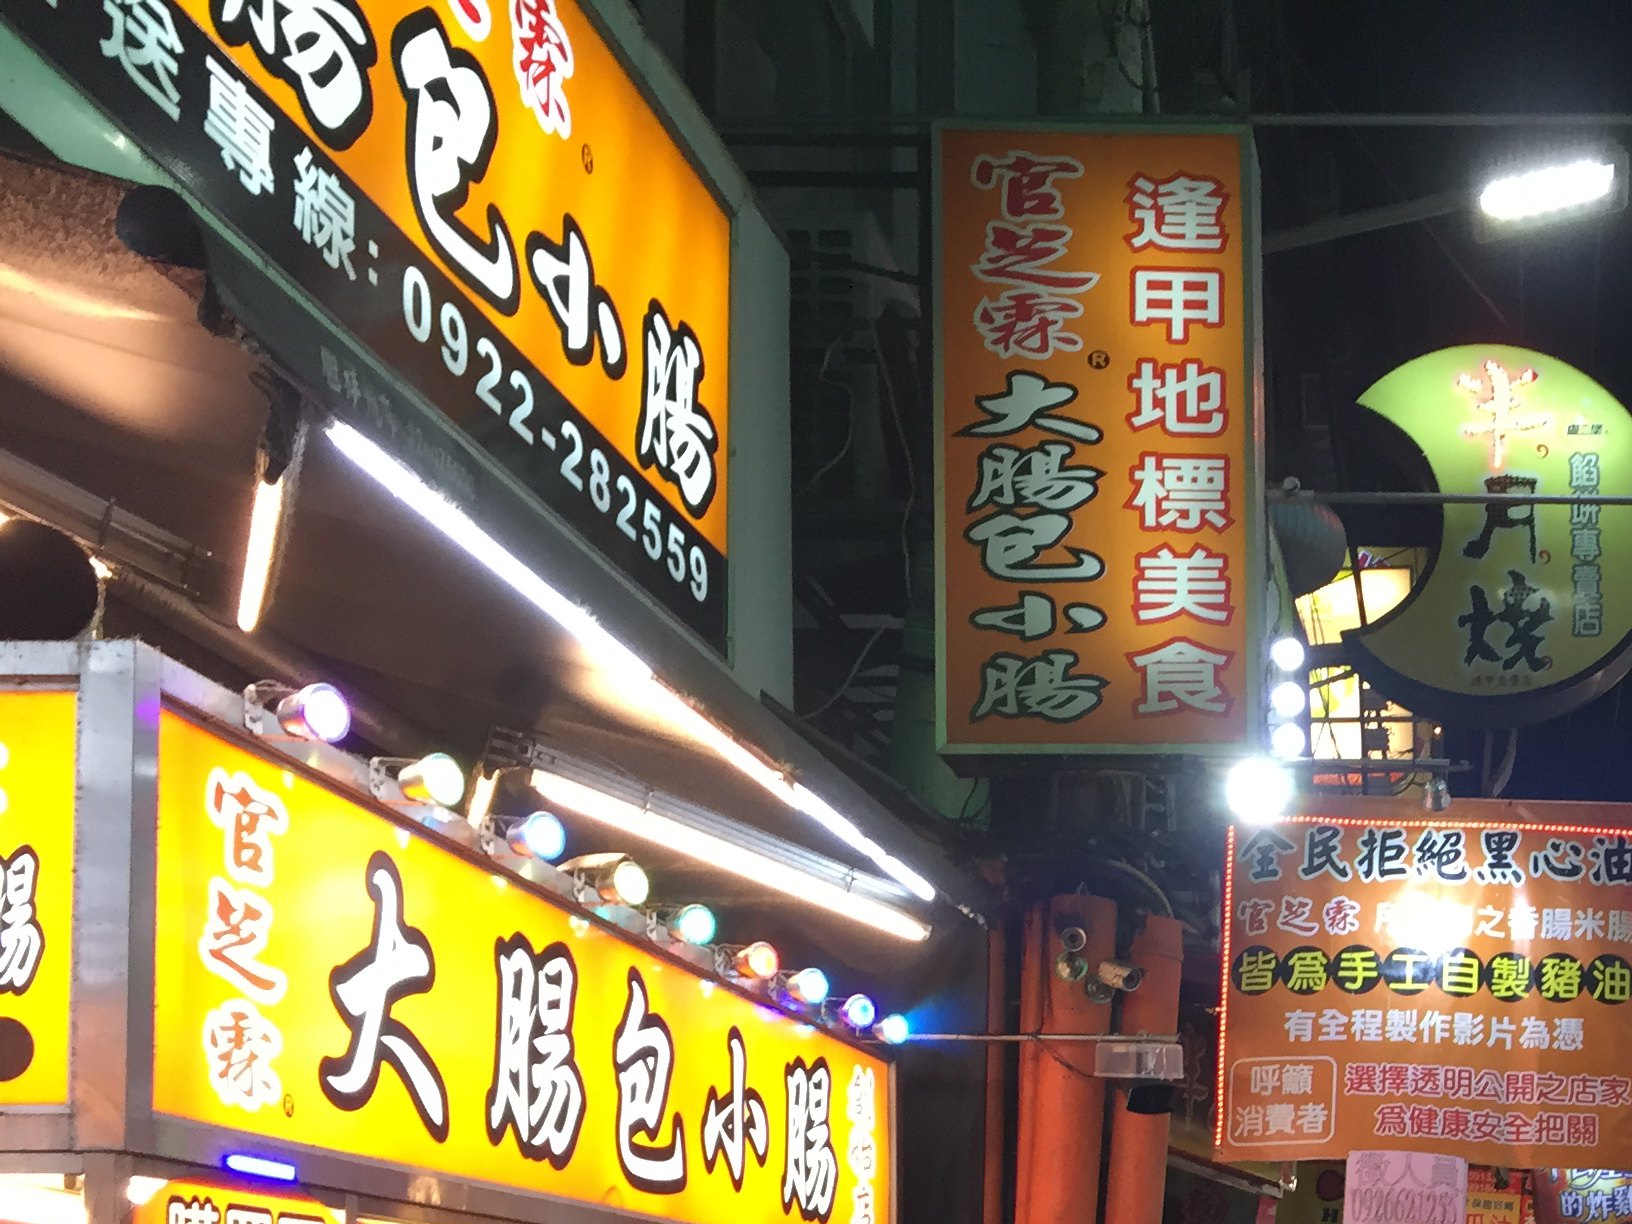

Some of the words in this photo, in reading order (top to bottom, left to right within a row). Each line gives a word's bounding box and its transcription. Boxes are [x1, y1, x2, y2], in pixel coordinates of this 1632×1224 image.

[971, 150, 1099, 359] 官芝霖
[402, 265, 709, 602] 0922-282559
[955, 371, 1107, 724] 大腸包小腸
[1127, 173, 1232, 716] 逢甲地標美食
[1456, 359, 1554, 672] 半月燒
[205, 769, 288, 1112] 官芝霖
[319, 852, 839, 1224] 大腸包小腸
[1250, 1064, 1312, 1096] 呼籲
[1284, 1010, 1584, 1050] 有全程製作影片為憑
[1344, 1064, 1632, 1106] 選擇透明公開之店家
[1236, 1103, 1328, 1136] 消費者
